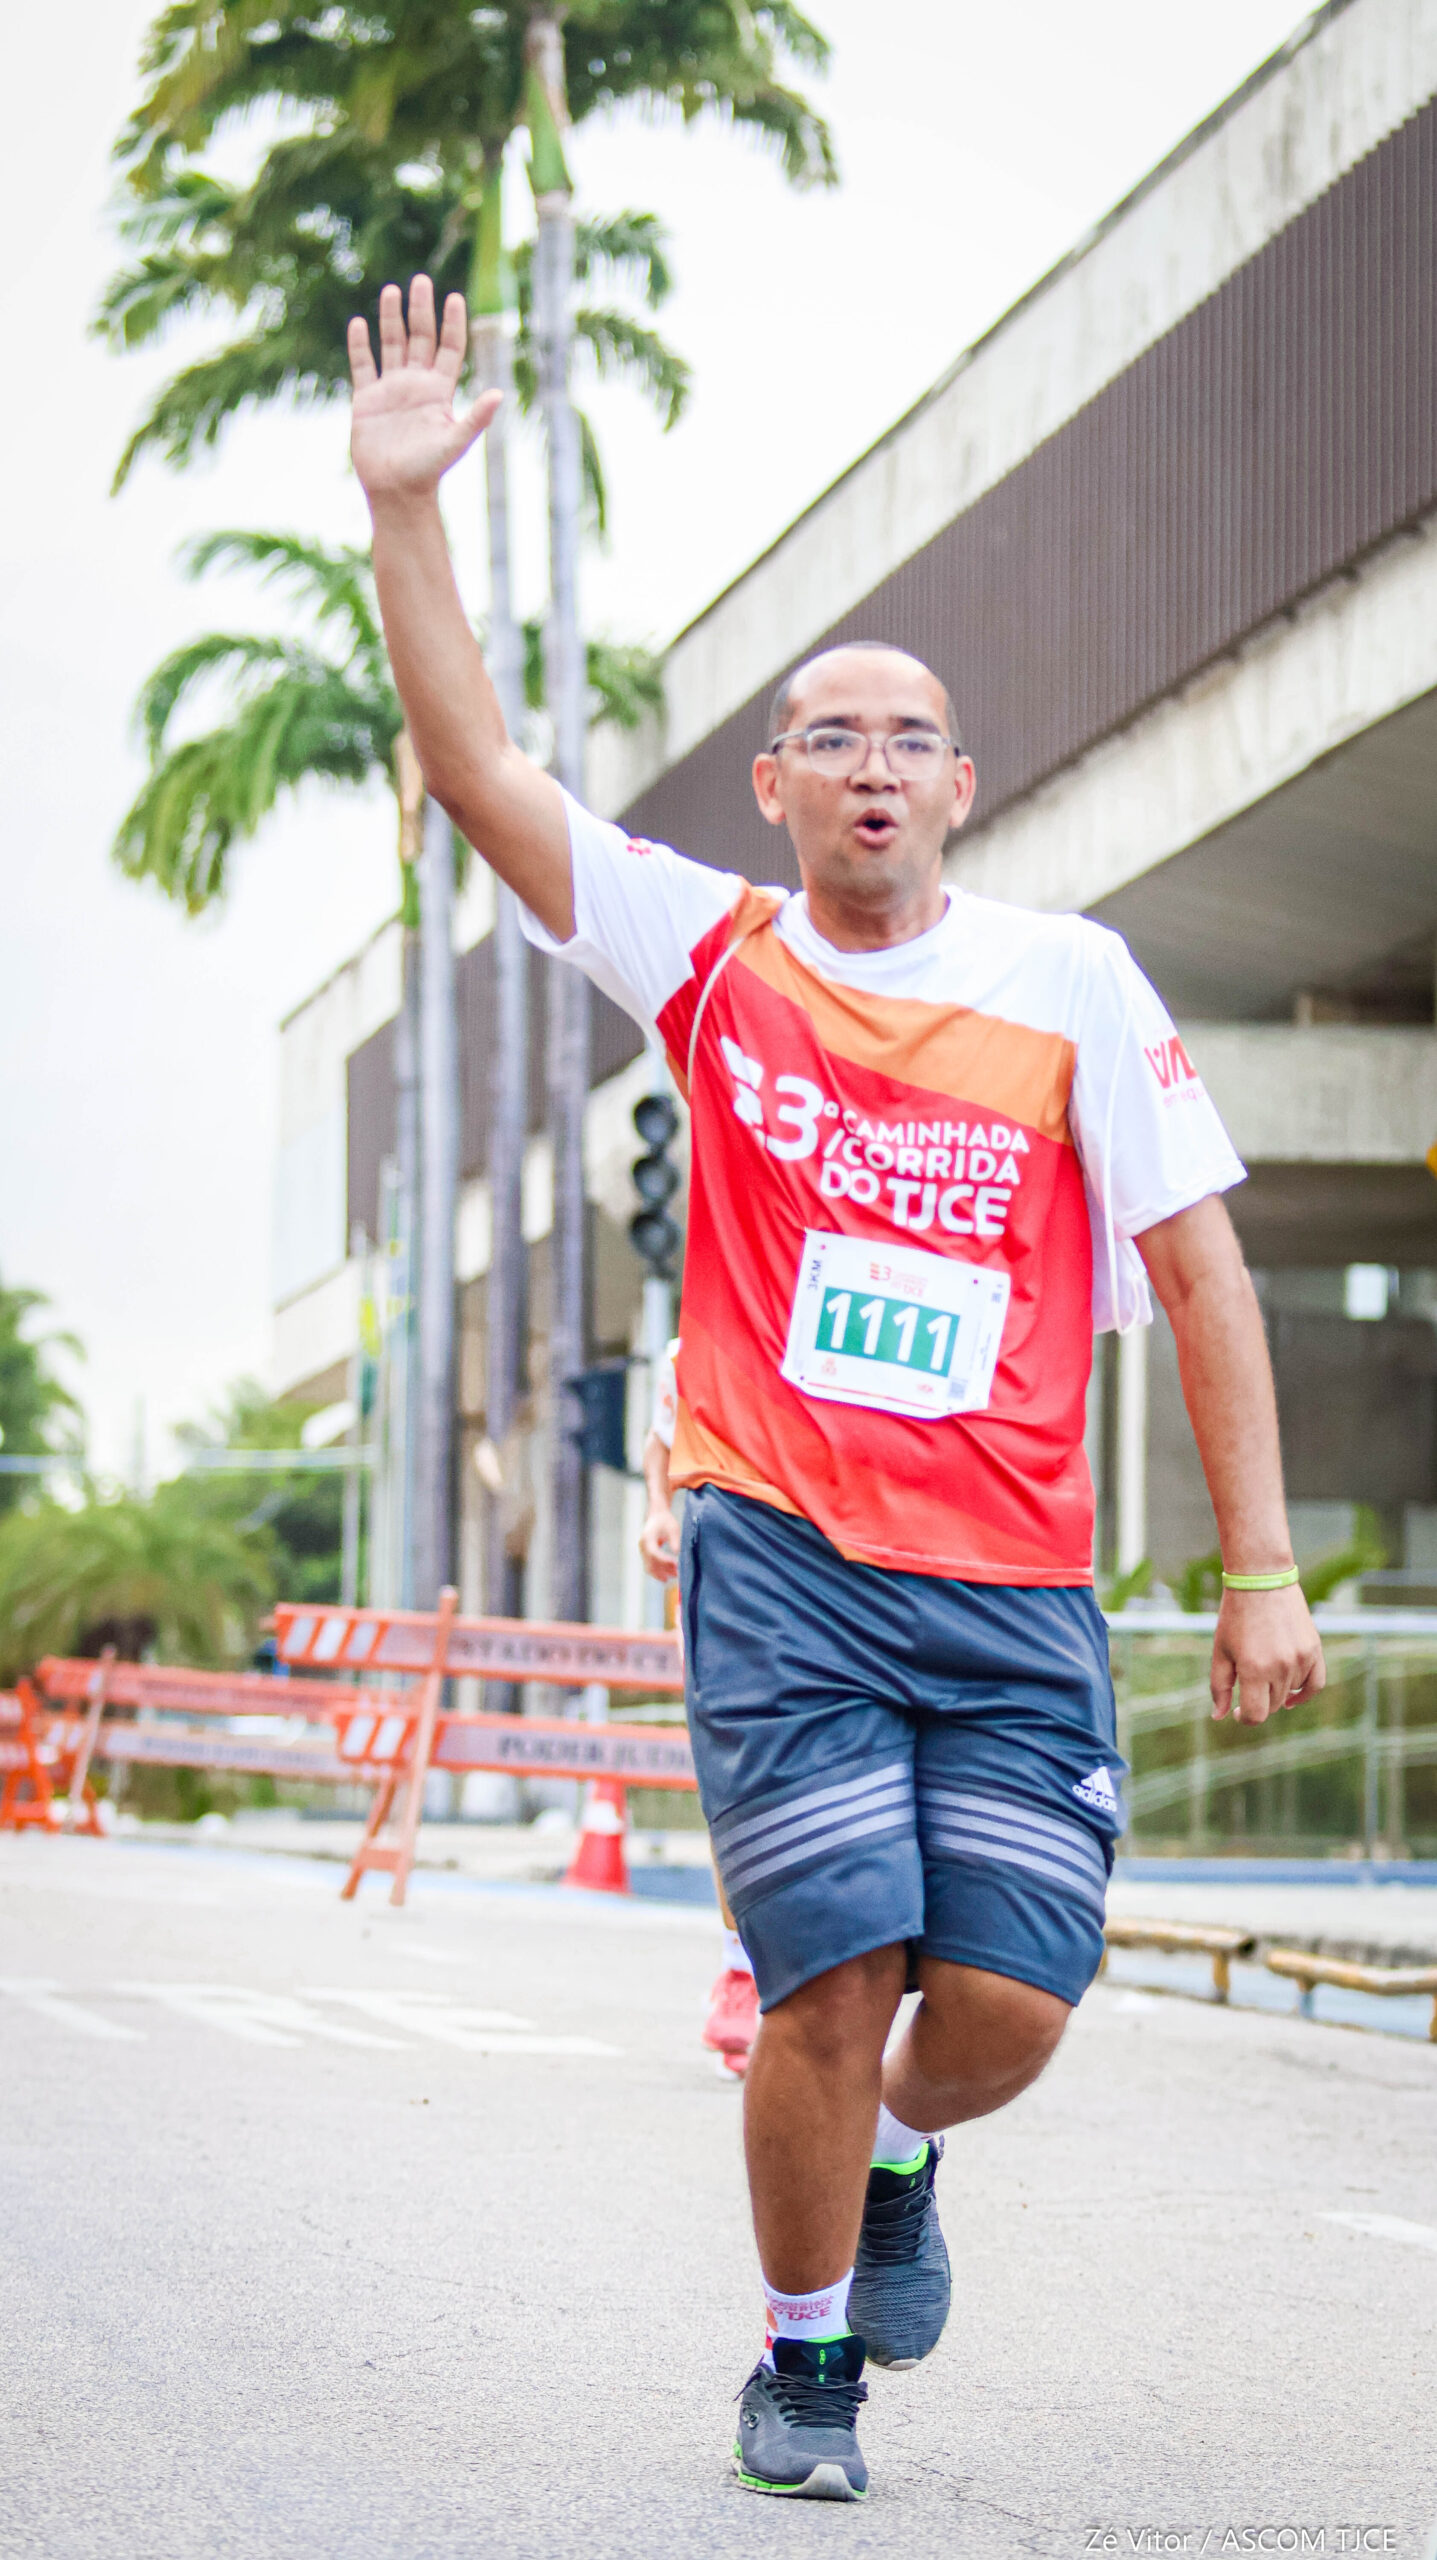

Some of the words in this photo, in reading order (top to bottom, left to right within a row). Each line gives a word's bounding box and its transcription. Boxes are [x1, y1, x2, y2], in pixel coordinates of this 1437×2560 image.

[843, 1109, 1030, 1153] CAMINHADA
[819, 1160, 881, 1204] DO
[886, 1176, 1012, 1236] TJCE
[825, 1292, 952, 1372] 1111
[1072, 1784, 1117, 1813] adidas
[786, 2306, 832, 2321] TJCE
